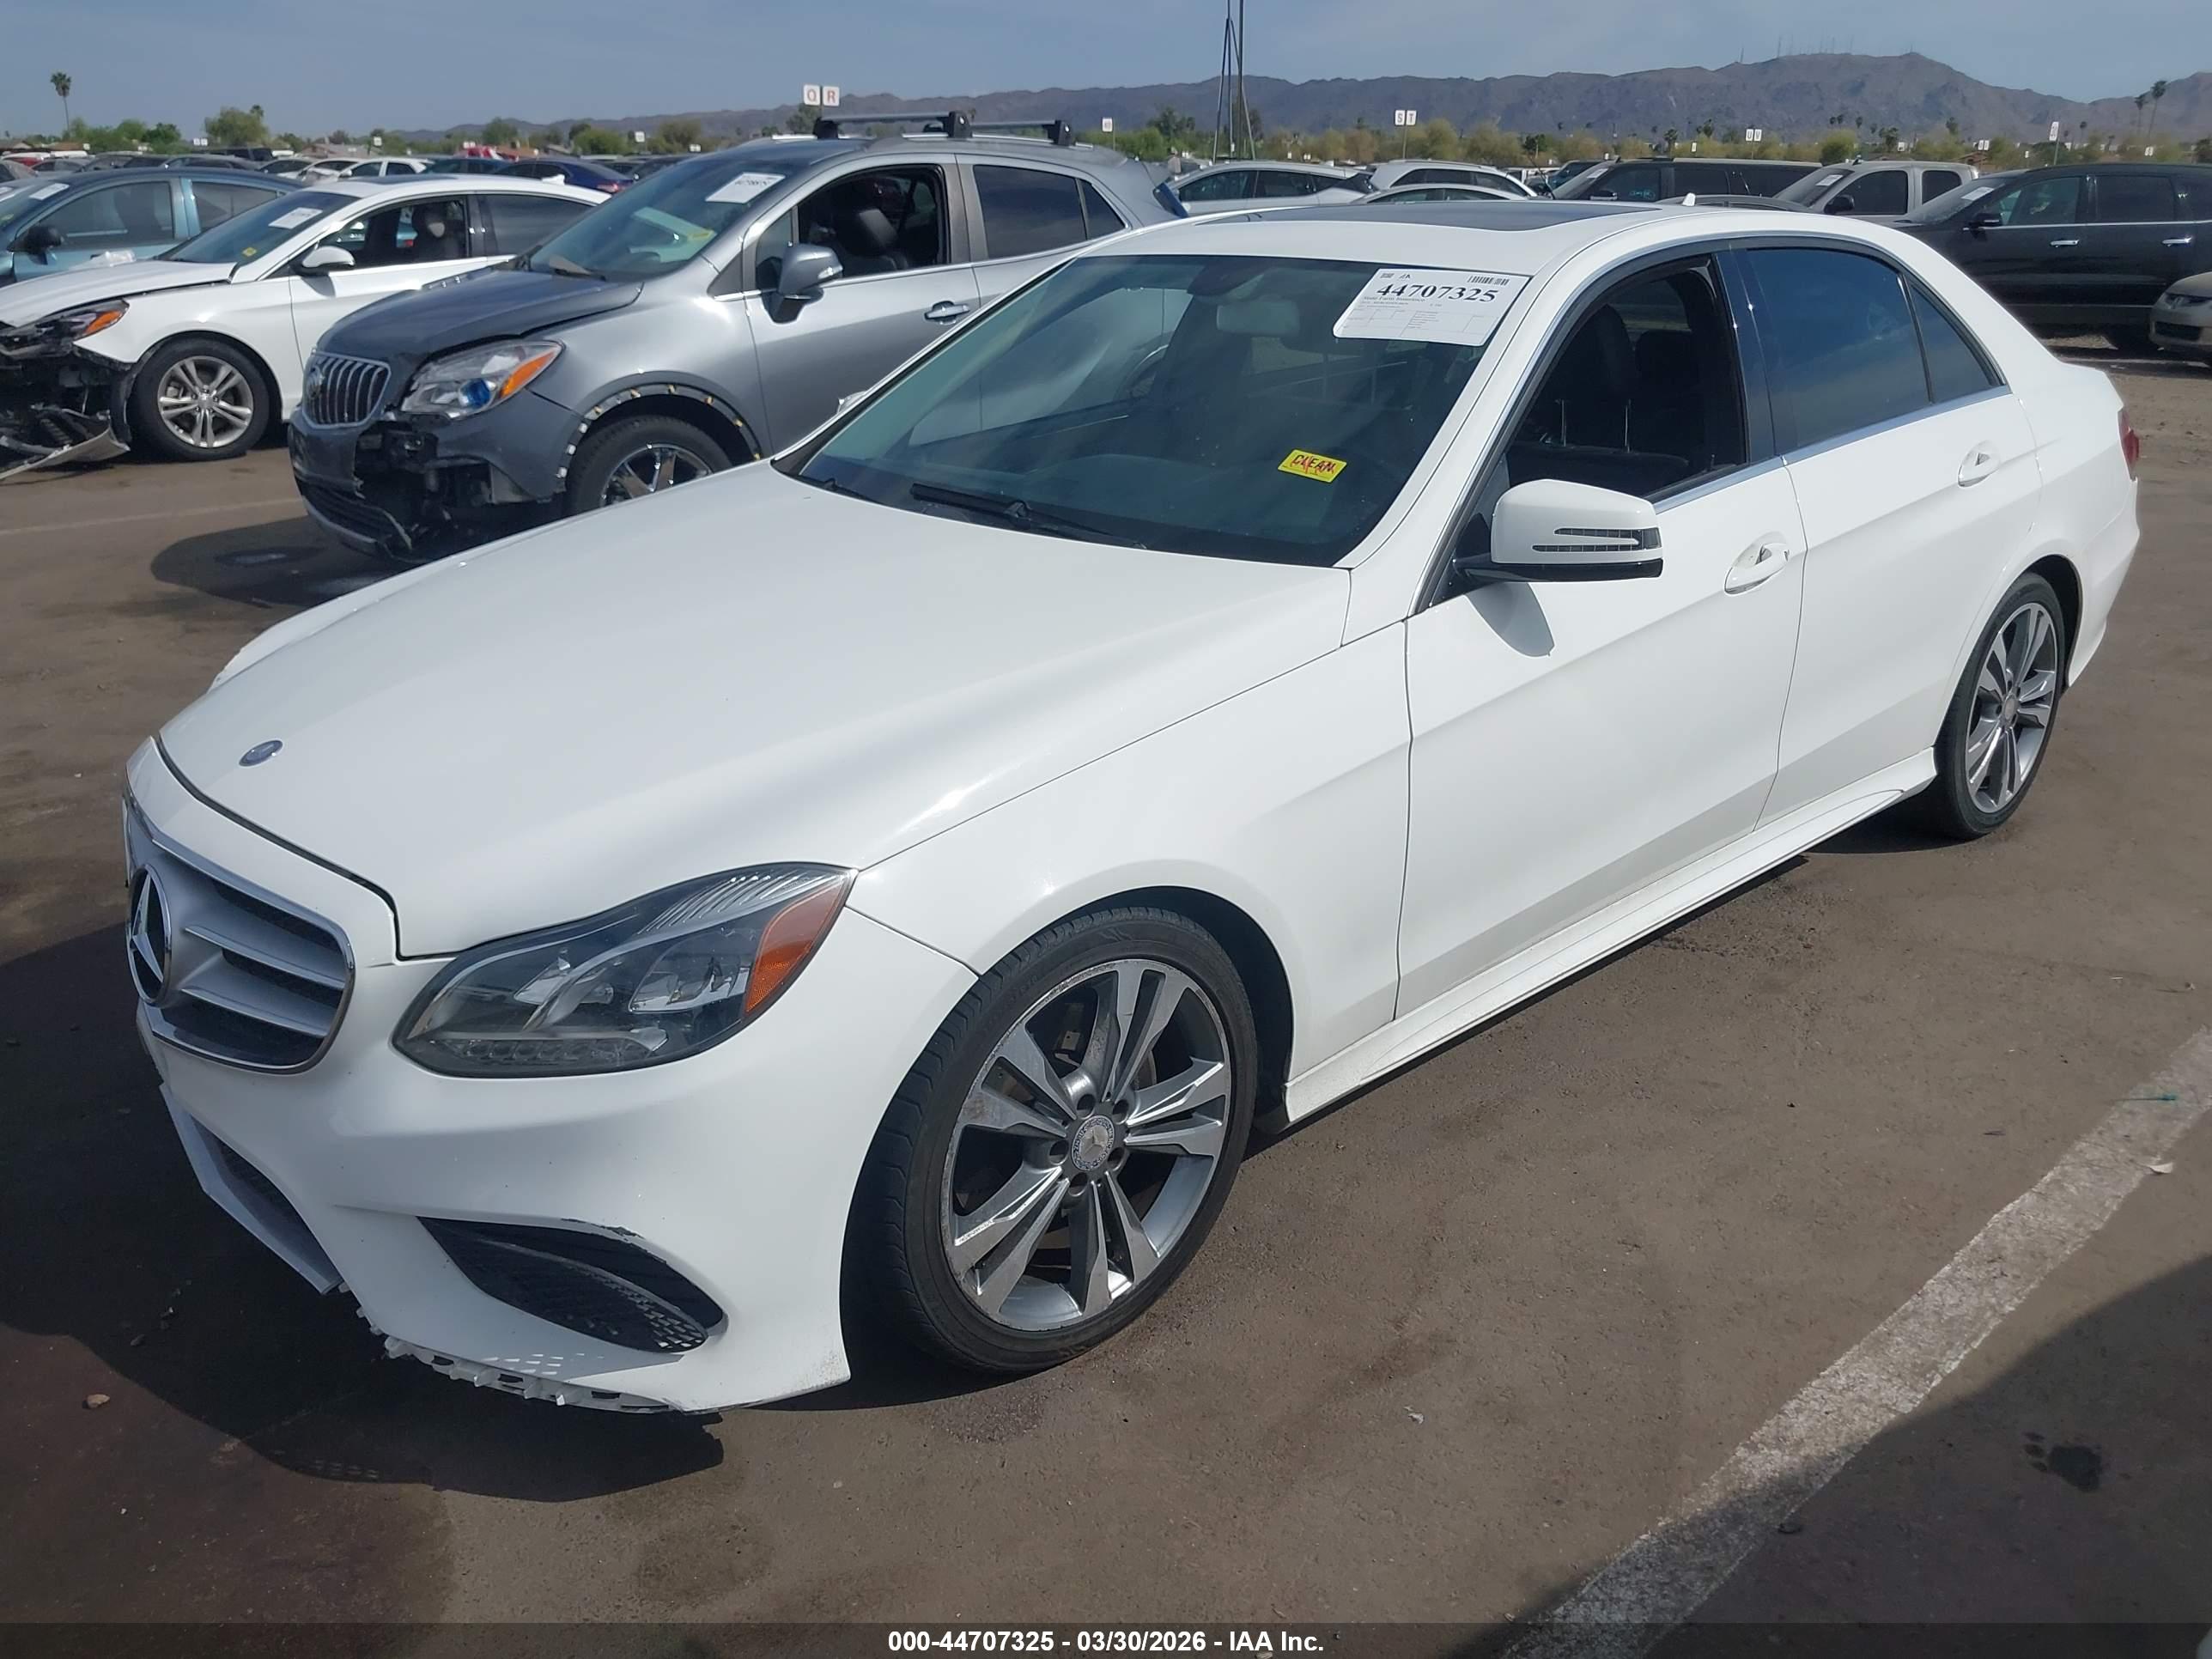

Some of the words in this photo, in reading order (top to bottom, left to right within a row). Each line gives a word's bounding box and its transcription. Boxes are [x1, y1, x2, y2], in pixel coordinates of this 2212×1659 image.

[807, 88, 817, 102] Q
[827, 89, 836, 103] R
[1376, 283, 1499, 303] 44707325
